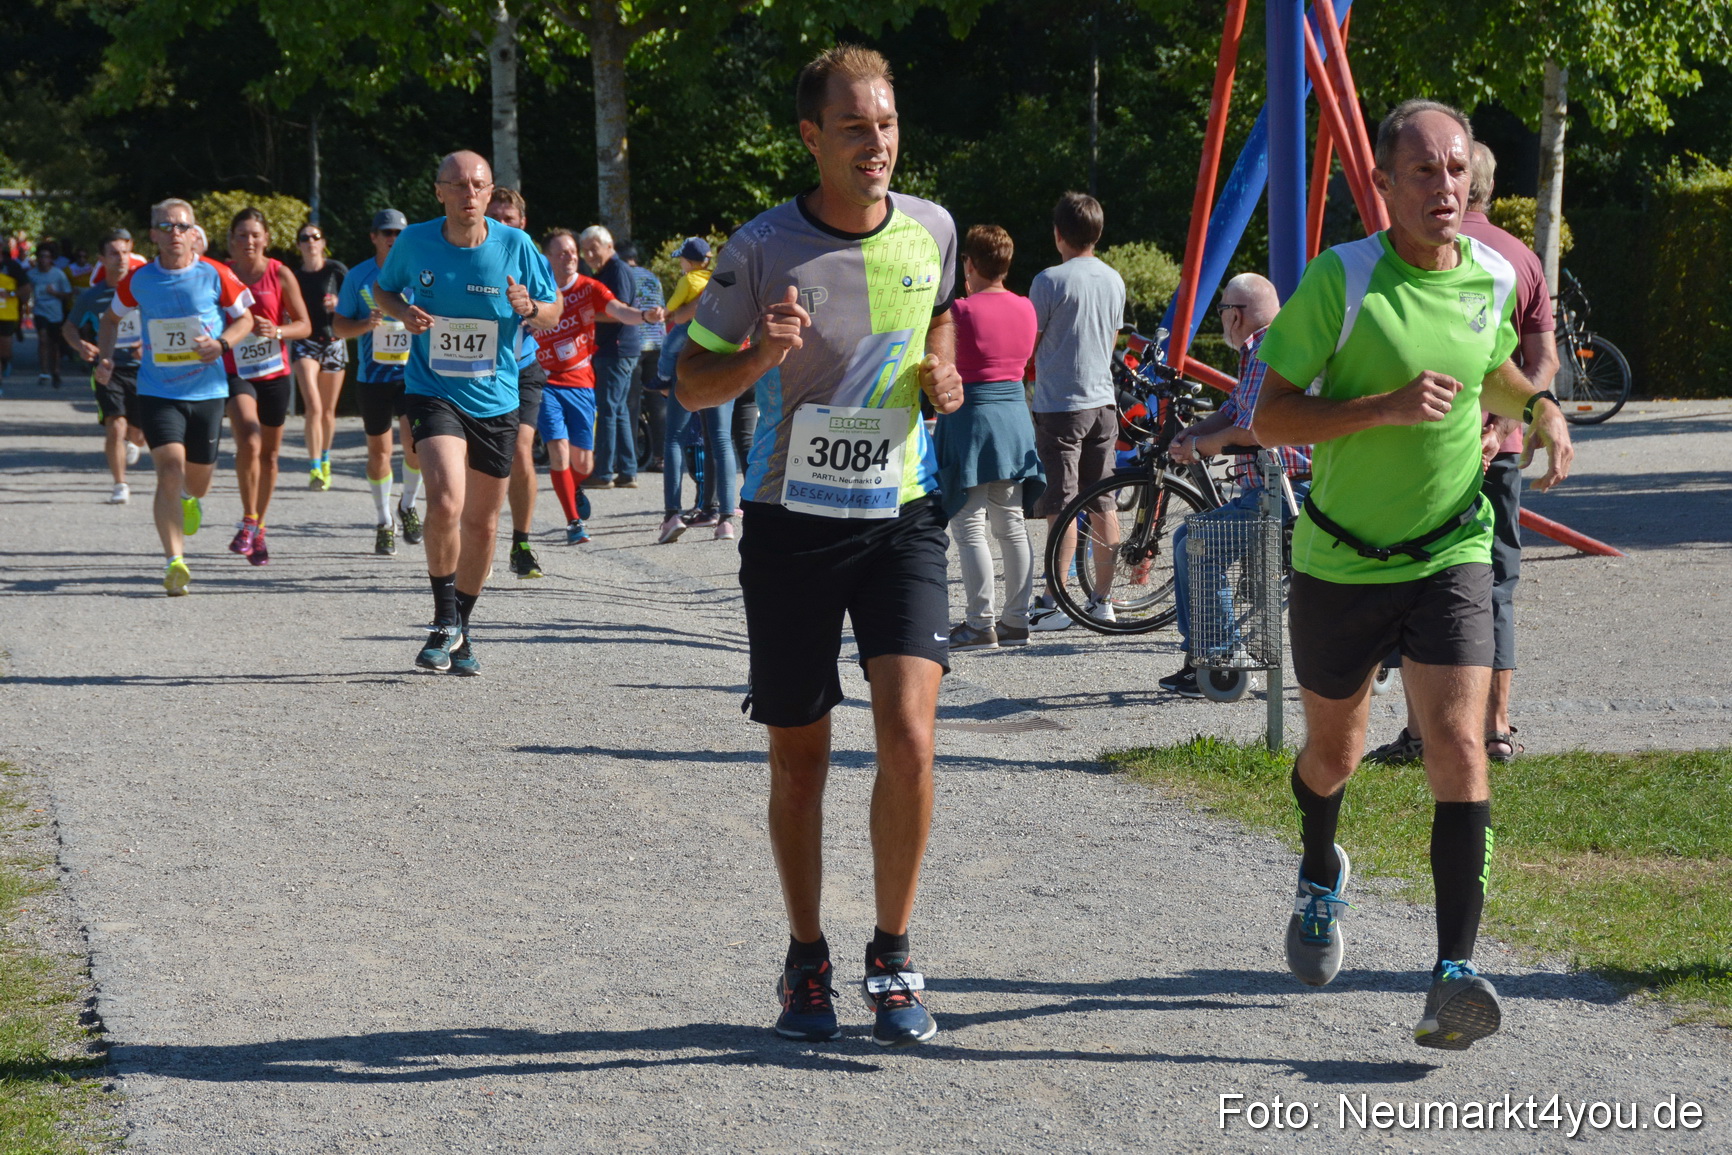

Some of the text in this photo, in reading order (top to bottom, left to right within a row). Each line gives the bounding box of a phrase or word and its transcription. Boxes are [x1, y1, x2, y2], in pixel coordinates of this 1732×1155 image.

[466, 284, 500, 295] BOCK
[166, 331, 186, 347] 73
[385, 333, 408, 347] 173
[440, 333, 487, 352] 3147
[240, 341, 273, 360] 2557
[829, 417, 881, 430] BOCK
[807, 436, 890, 472] 3084
[812, 472, 837, 482] PARTL
